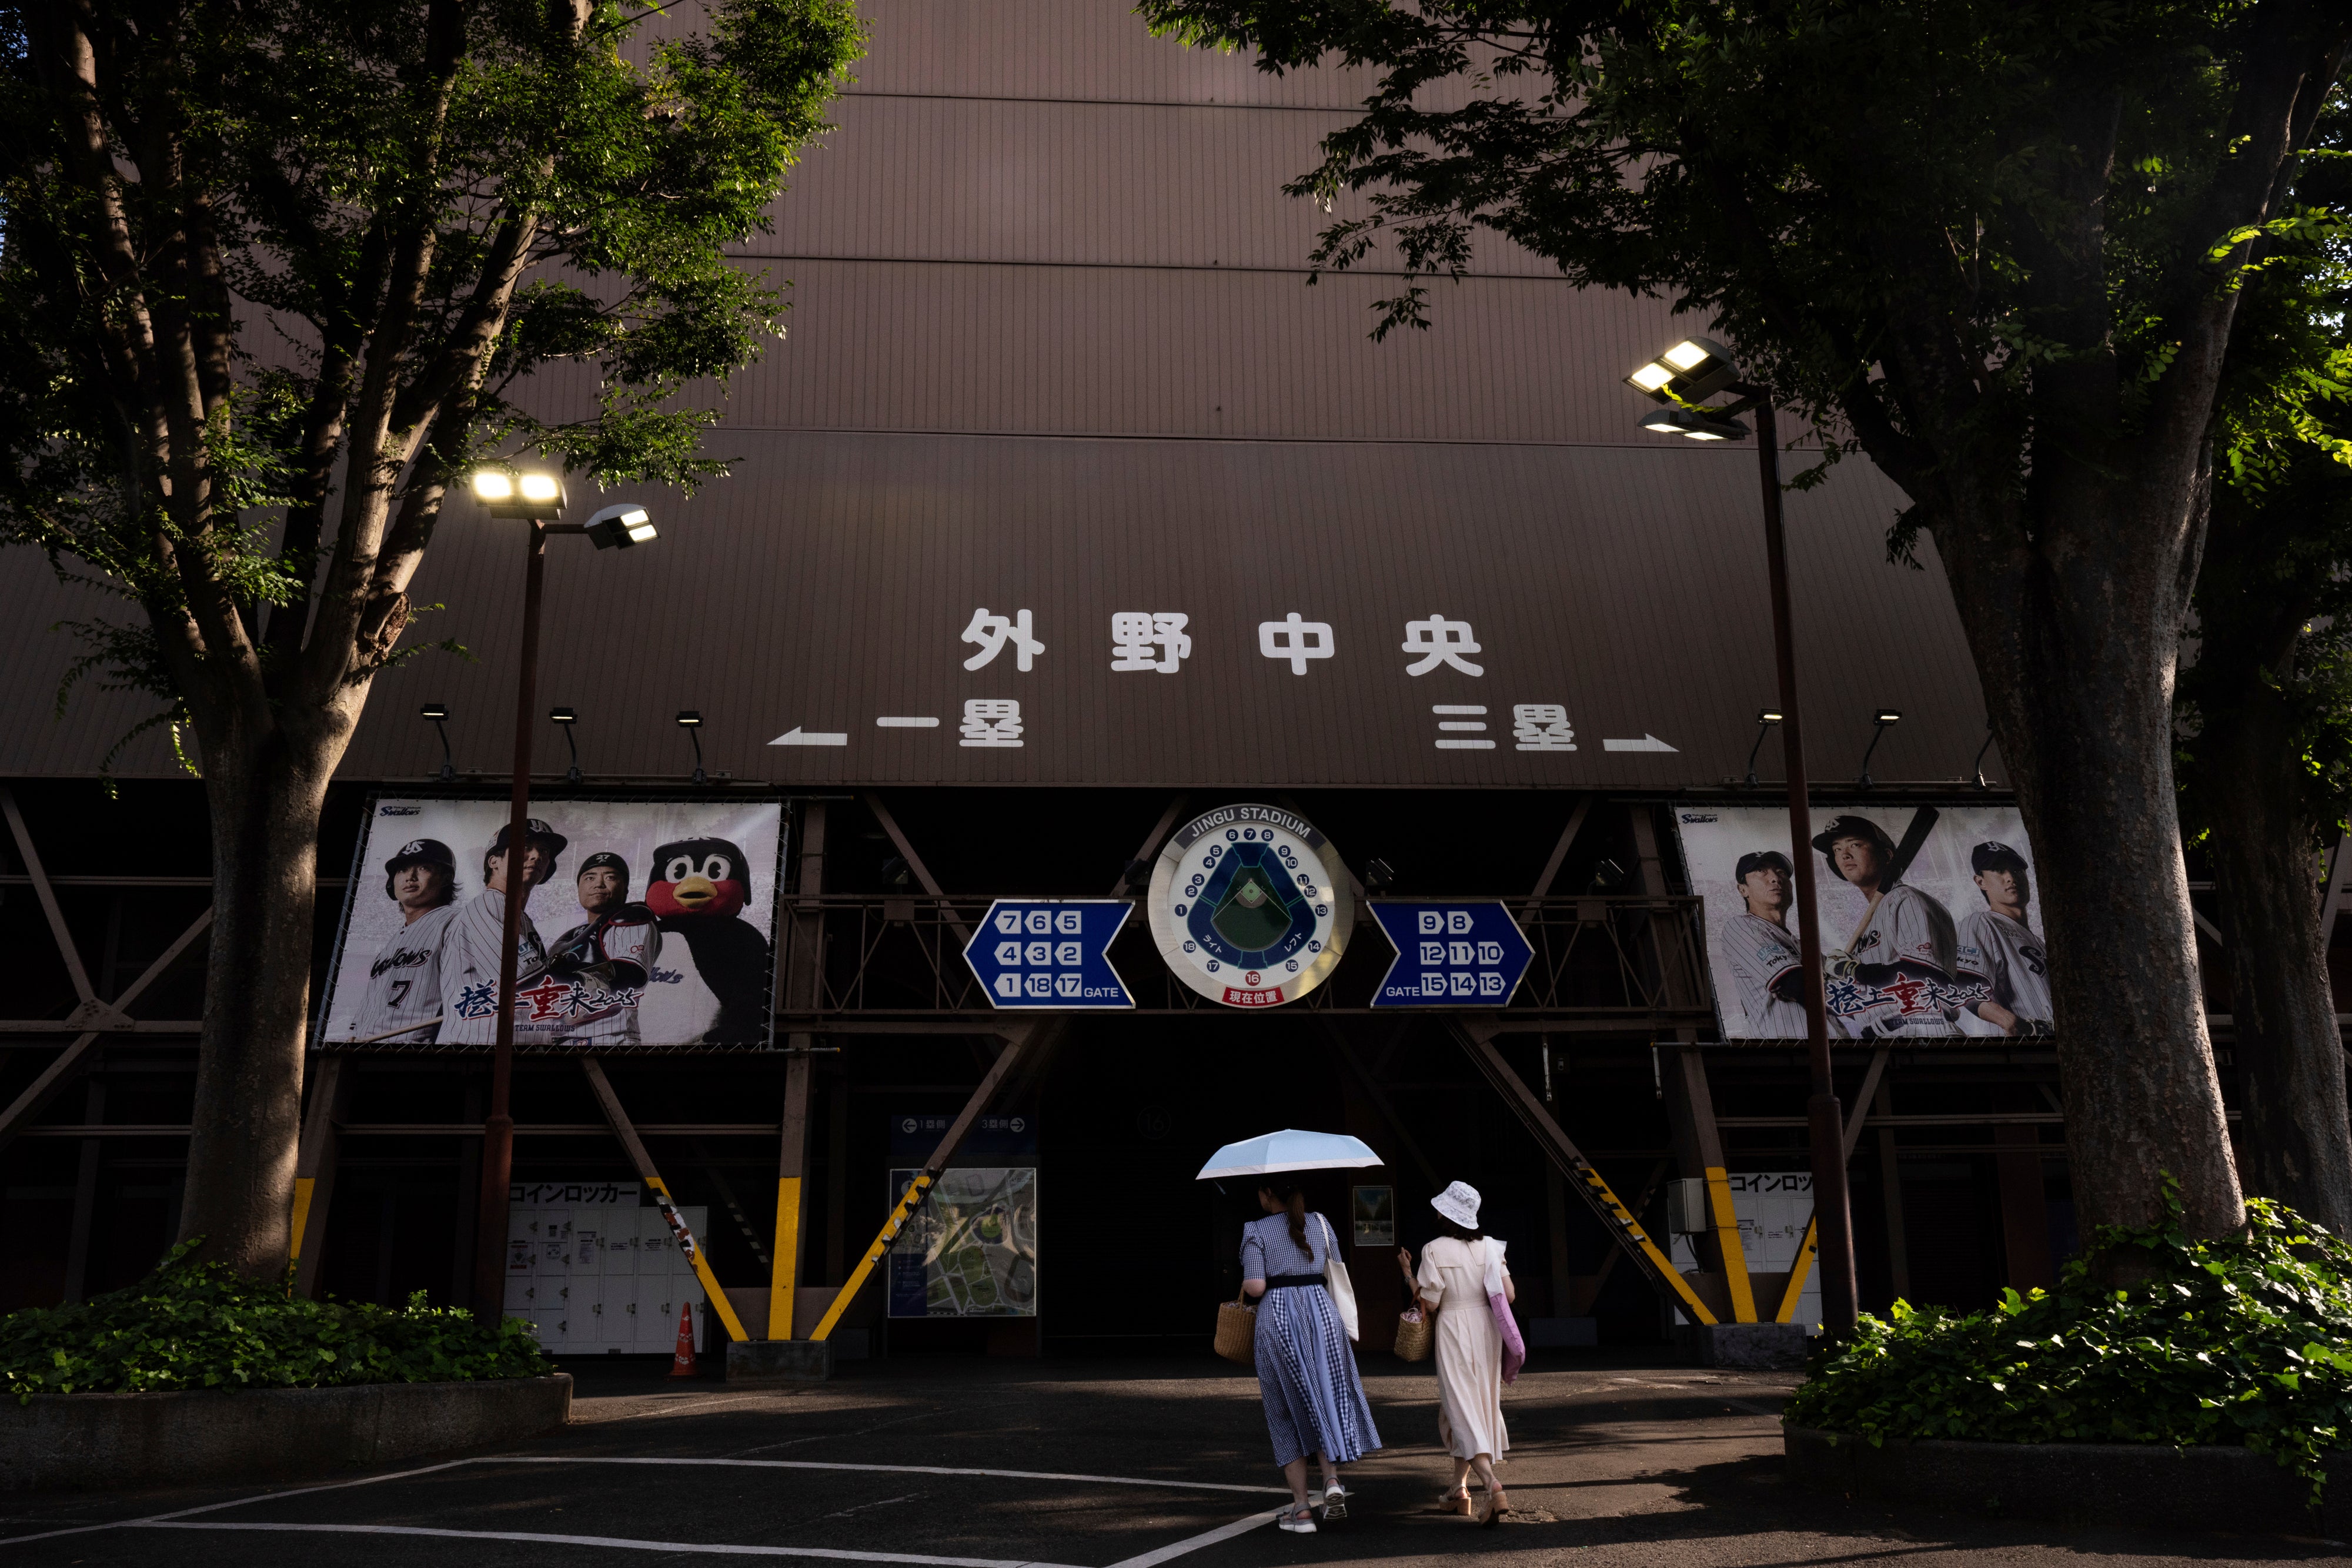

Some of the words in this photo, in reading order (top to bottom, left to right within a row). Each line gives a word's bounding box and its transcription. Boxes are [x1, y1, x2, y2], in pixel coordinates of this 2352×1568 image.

[876, 699, 1024, 747] 一塁
[1432, 704, 1578, 751] 三塁
[380, 806, 420, 816] Swallows
[1191, 808, 1235, 837] JINGU
[1240, 807, 1311, 838] STADIUM
[1682, 814, 1718, 824] Swallows
[1003, 915, 1017, 930] 7
[1033, 915, 1046, 930] 6
[1063, 915, 1077, 930] 5
[1423, 915, 1436, 930] 9
[1453, 915, 1466, 930] 8
[1202, 934, 1222, 954] ライト
[1284, 932, 1302, 952] レフト
[1003, 946, 1017, 961] 4
[1033, 946, 1046, 961] 3
[1063, 946, 1077, 961] 2
[1421, 946, 1442, 961] 12
[1451, 946, 1470, 961] 11
[1479, 945, 1501, 960] 10
[1957, 945, 1980, 957] ACJ
[1957, 957, 1979, 965] kyo
[1247, 974, 1259, 983] 16
[1005, 978, 1014, 992] 1
[1029, 978, 1051, 992] 18
[1059, 977, 1080, 992] 17
[1084, 987, 1118, 998] GATE
[1386, 987, 1420, 997] GATE
[1422, 977, 1444, 991] 15
[1452, 977, 1474, 991] 14
[1480, 976, 1502, 991] 13
[387, 980, 412, 1009] 7
[1229, 990, 1278, 1004] 現在位置
[1909, 1017, 1945, 1025] SWALLOWS
[919, 1119, 946, 1129] 1塁側
[981, 1119, 1008, 1129] 3塁側
[1730, 1174, 1813, 1193] コインロッ
[510, 1183, 637, 1203] コインロッカー
